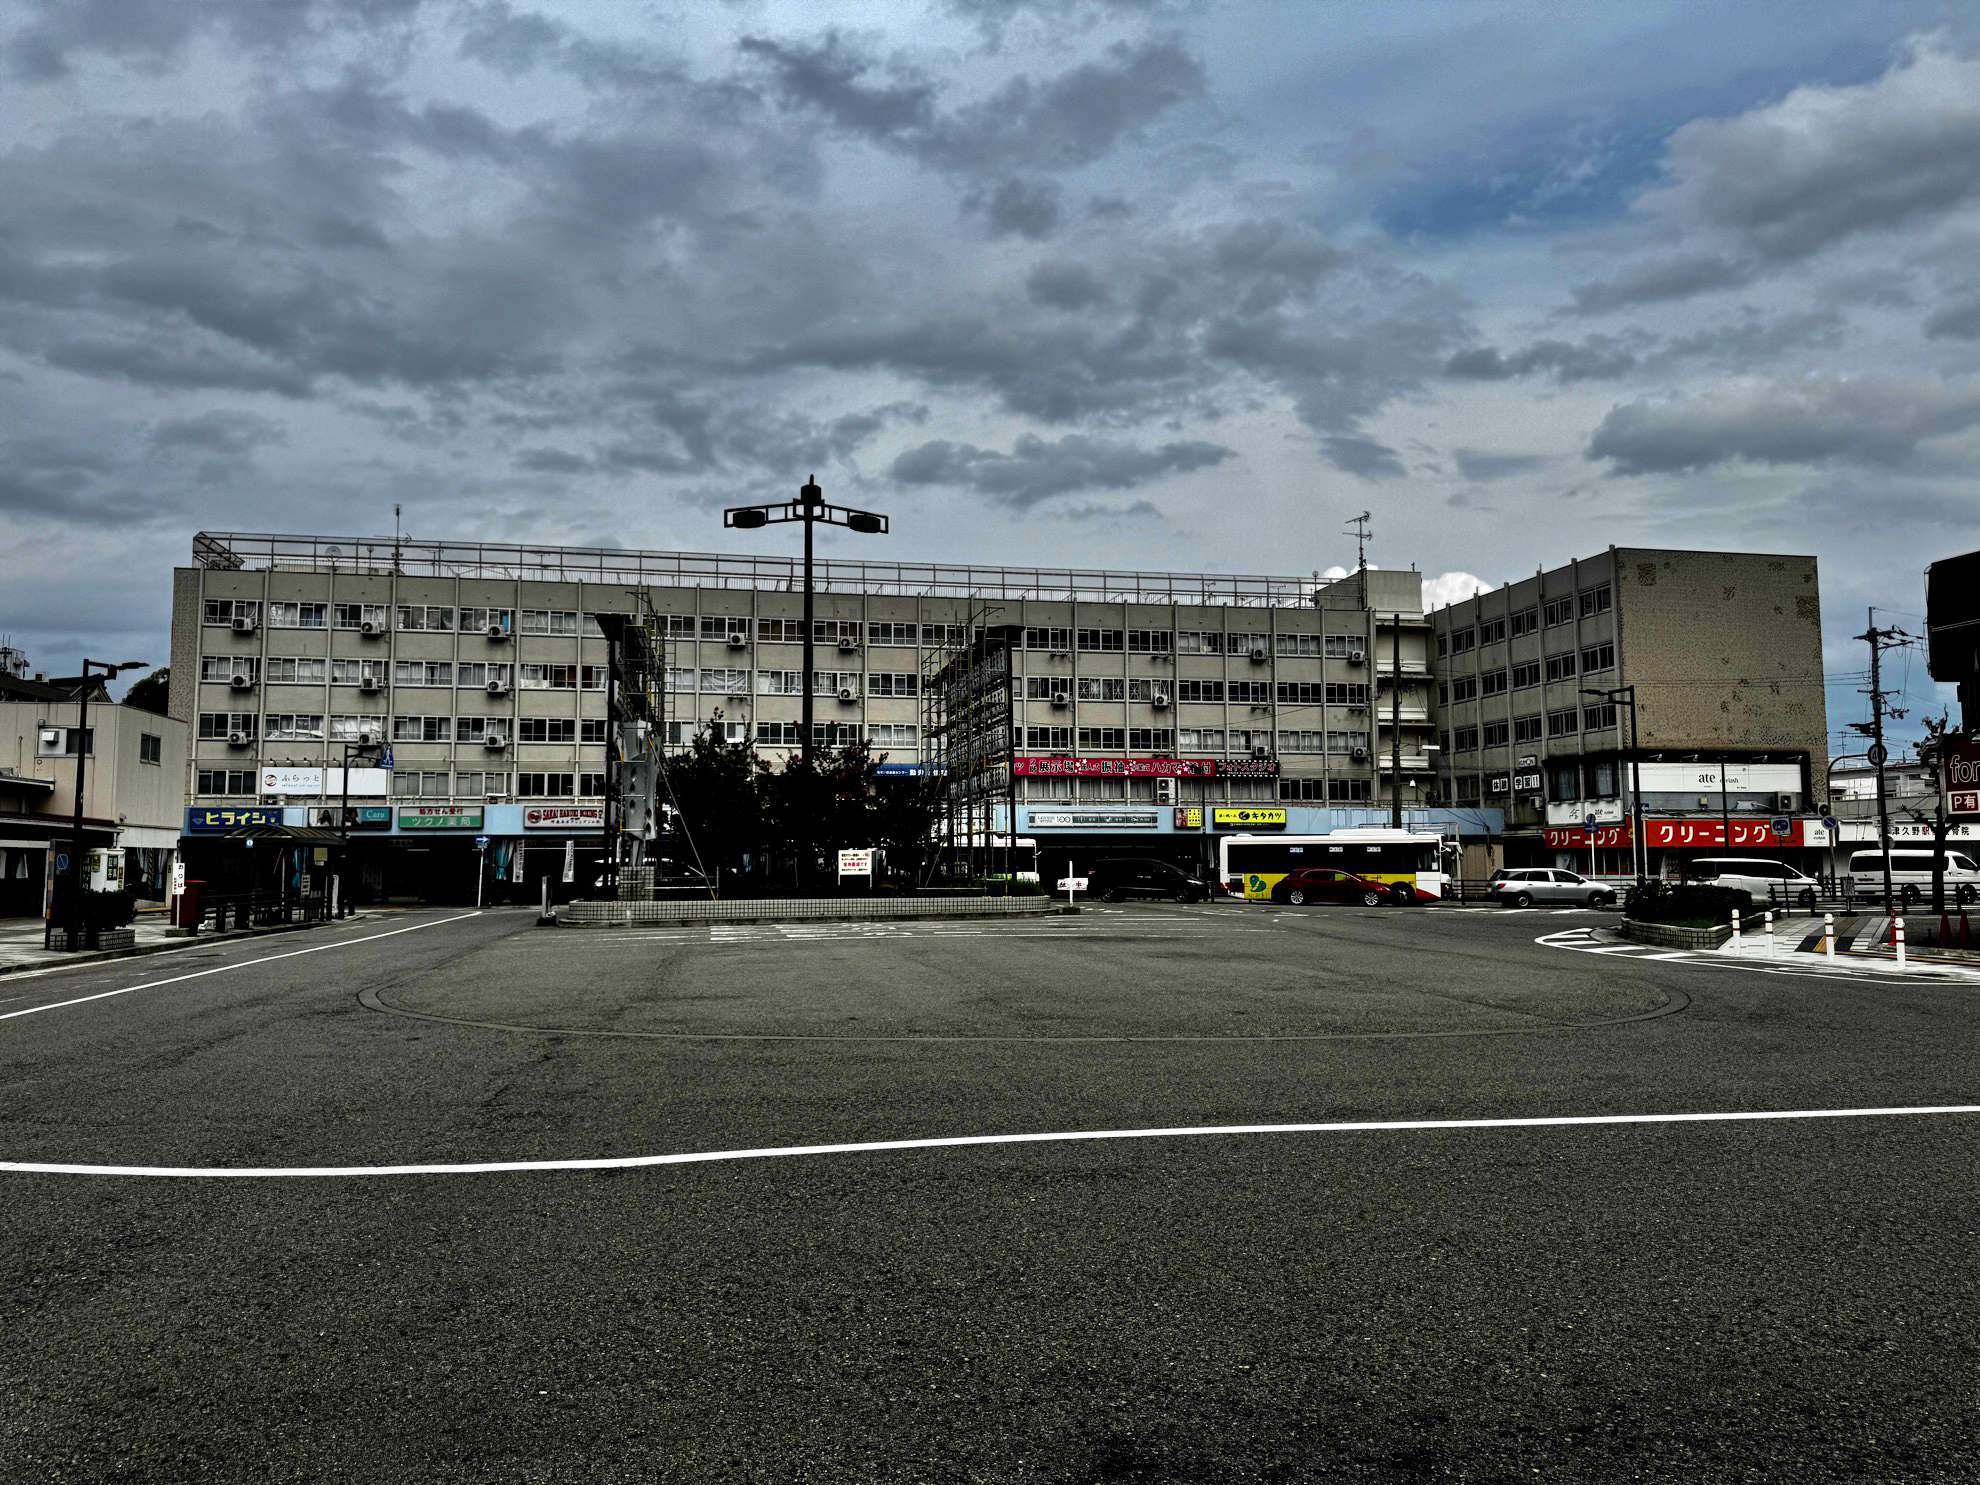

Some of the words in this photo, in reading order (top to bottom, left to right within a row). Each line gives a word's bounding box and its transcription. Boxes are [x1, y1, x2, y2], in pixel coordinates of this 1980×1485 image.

[1039, 759, 1074, 773] 展示場
[1151, 761, 1179, 774] ハカマ
[1217, 761, 1276, 772] フォトスタジオ
[1698, 773, 1716, 784] ate
[205, 811, 266, 825] ヒライシ
[1251, 812, 1281, 820] キタカツ
[1660, 824, 1770, 843] クリーニング
[1892, 826, 1970, 836] 津久野駅骨院
